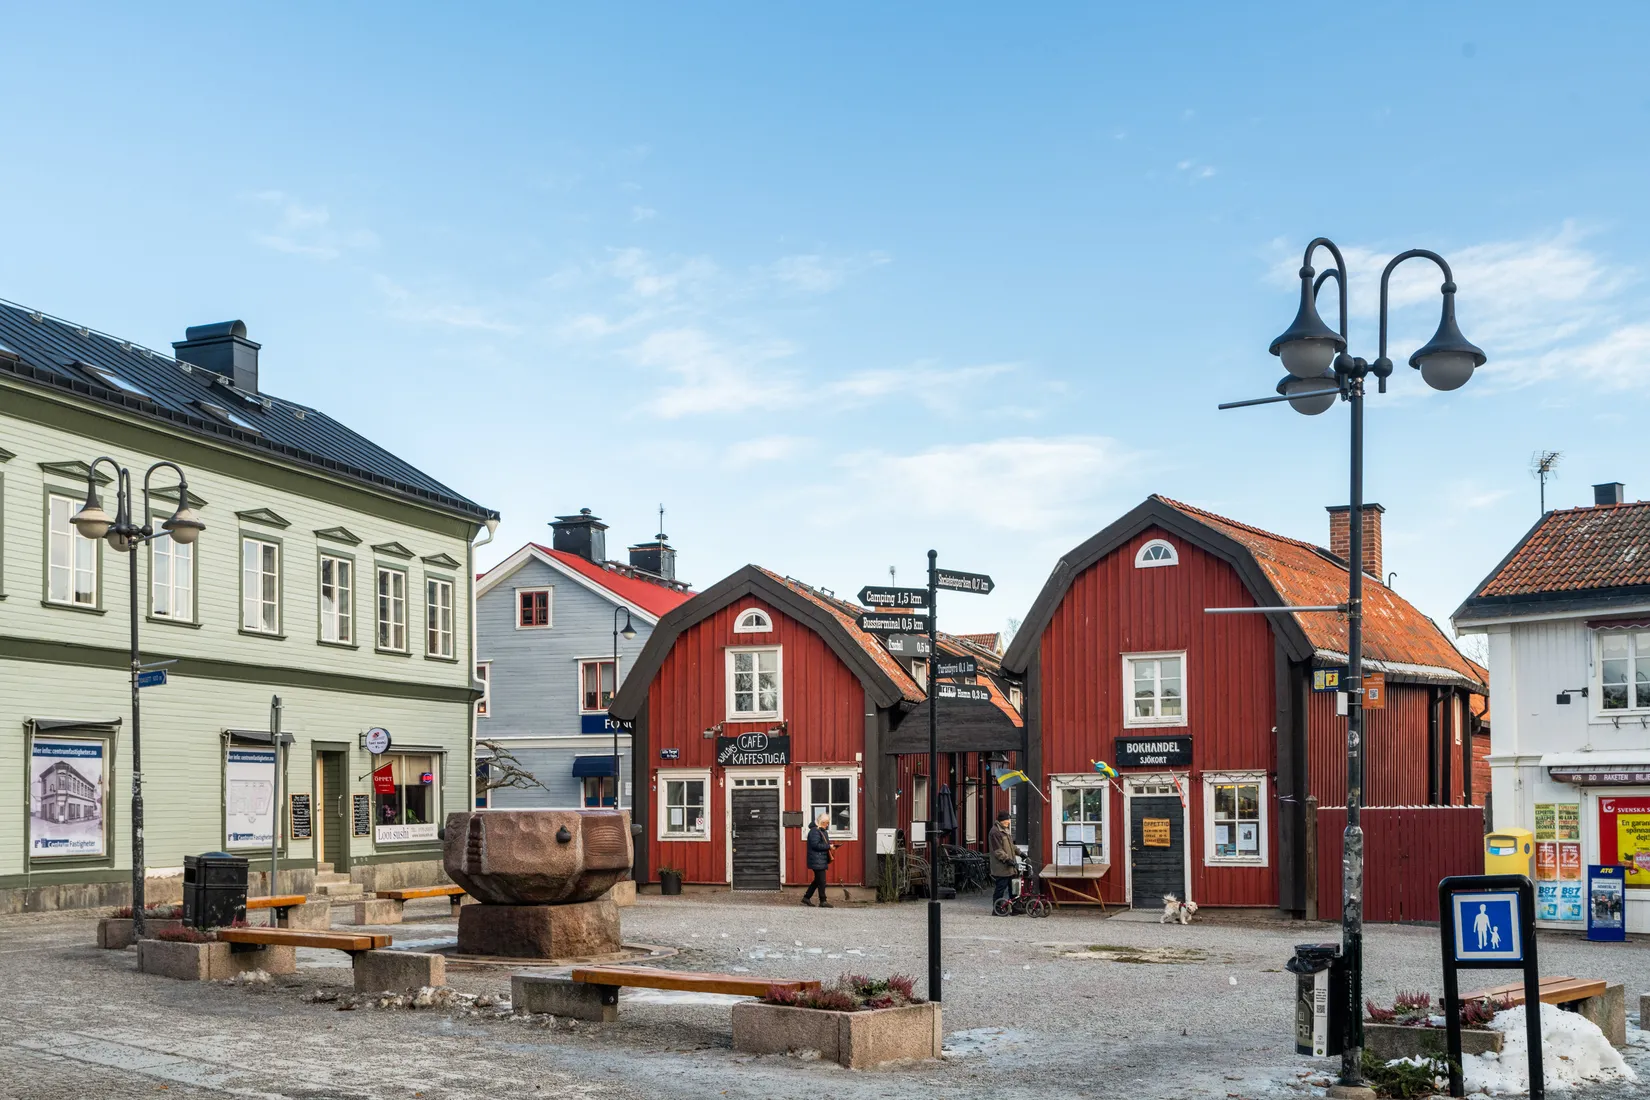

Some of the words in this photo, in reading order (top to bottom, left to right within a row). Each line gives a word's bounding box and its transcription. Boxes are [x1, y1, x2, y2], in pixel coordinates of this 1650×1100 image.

[972, 578, 980, 591] 0,7
[981, 579, 988, 590] km
[866, 591, 895, 606] Camping
[897, 592, 909, 605] 1,5
[910, 593, 922, 604] km
[863, 617, 900, 629] Bussterminal
[902, 618, 912, 631] 0,5
[913, 618, 924, 630] km
[967, 662, 974, 672] km
[957, 689, 971, 698] Hamn
[972, 690, 980, 700] 0,3
[980, 690, 988, 700] km
[741, 733, 763, 748] CAFÉ
[1126, 742, 1180, 753] BOKHANDEL
[732, 752, 786, 764] KAFFESTUGA
[1140, 755, 1167, 764] SJÖKORT
[378, 828, 392, 840] Looi
[393, 827, 409, 839] sushi
[70, 841, 95, 849] Fastigheter
